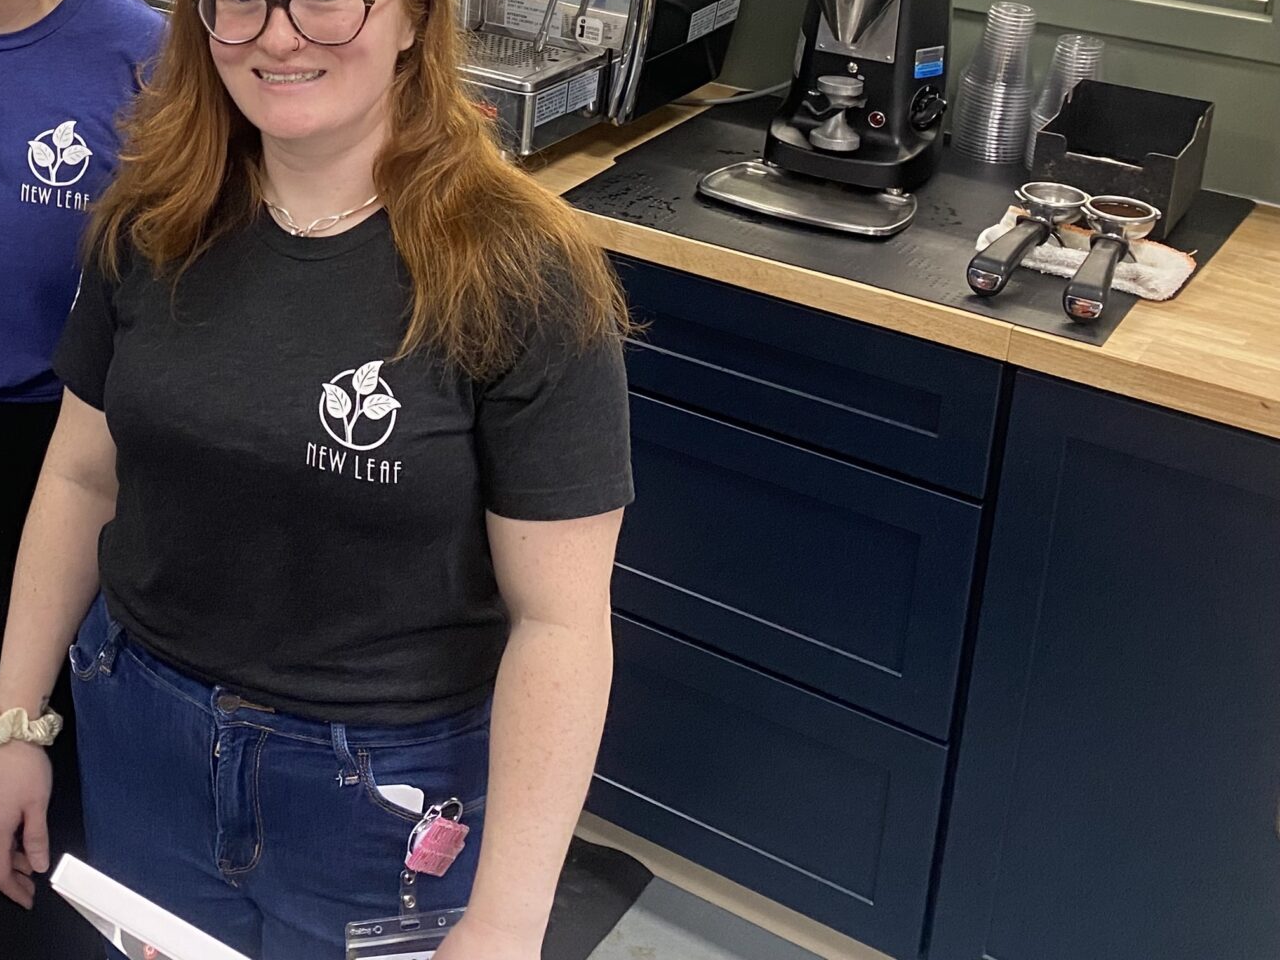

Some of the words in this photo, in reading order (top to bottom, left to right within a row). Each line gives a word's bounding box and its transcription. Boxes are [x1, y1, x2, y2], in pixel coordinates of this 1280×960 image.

[20, 183, 52, 205] NEW
[57, 189, 90, 211] LEAF
[306, 442, 347, 474] NEW
[355, 455, 402, 483] LEAF
